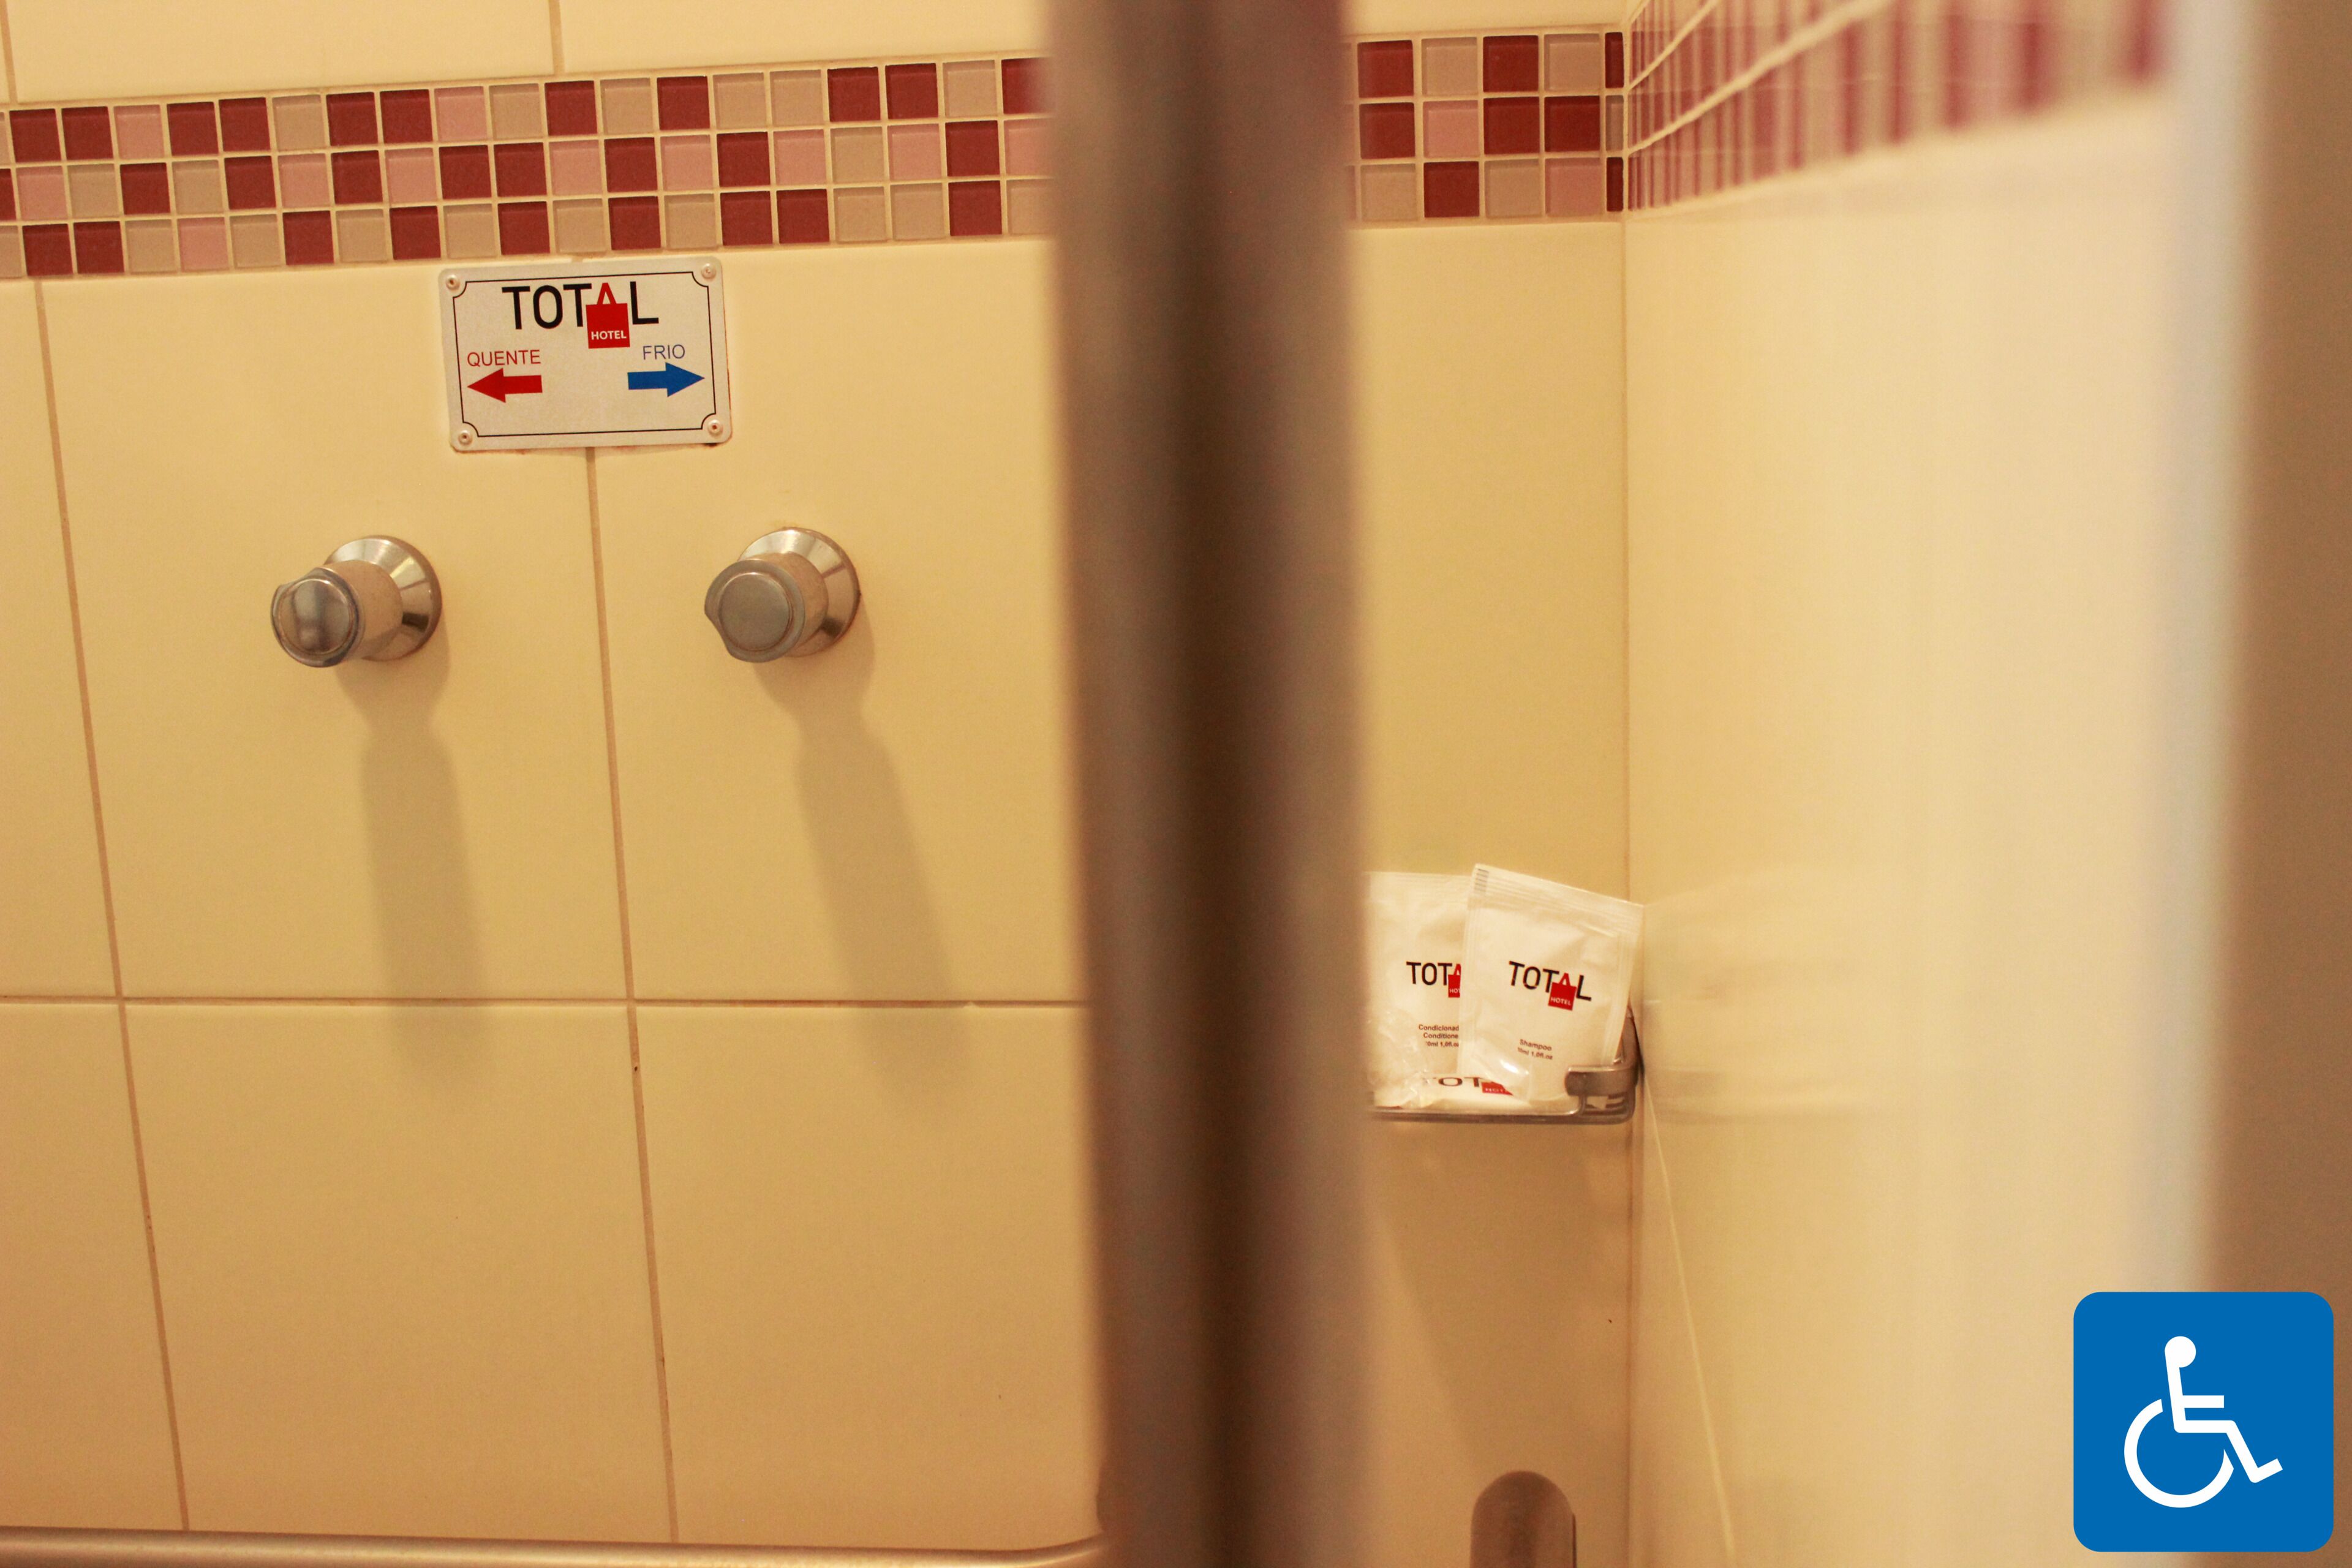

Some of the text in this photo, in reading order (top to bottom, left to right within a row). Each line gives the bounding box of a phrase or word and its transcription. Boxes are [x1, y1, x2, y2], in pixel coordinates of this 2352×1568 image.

[502, 281, 659, 330] TOTAL
[590, 330, 627, 340] HOTEL
[467, 349, 541, 367] QUENTE
[643, 344, 685, 360] FRIO
[1406, 961, 1461, 986] TOTA
[1509, 960, 1592, 1001] TOTAL
[1550, 997, 1572, 1006] HOTEL
[1519, 1039, 1552, 1051] Shampoo
